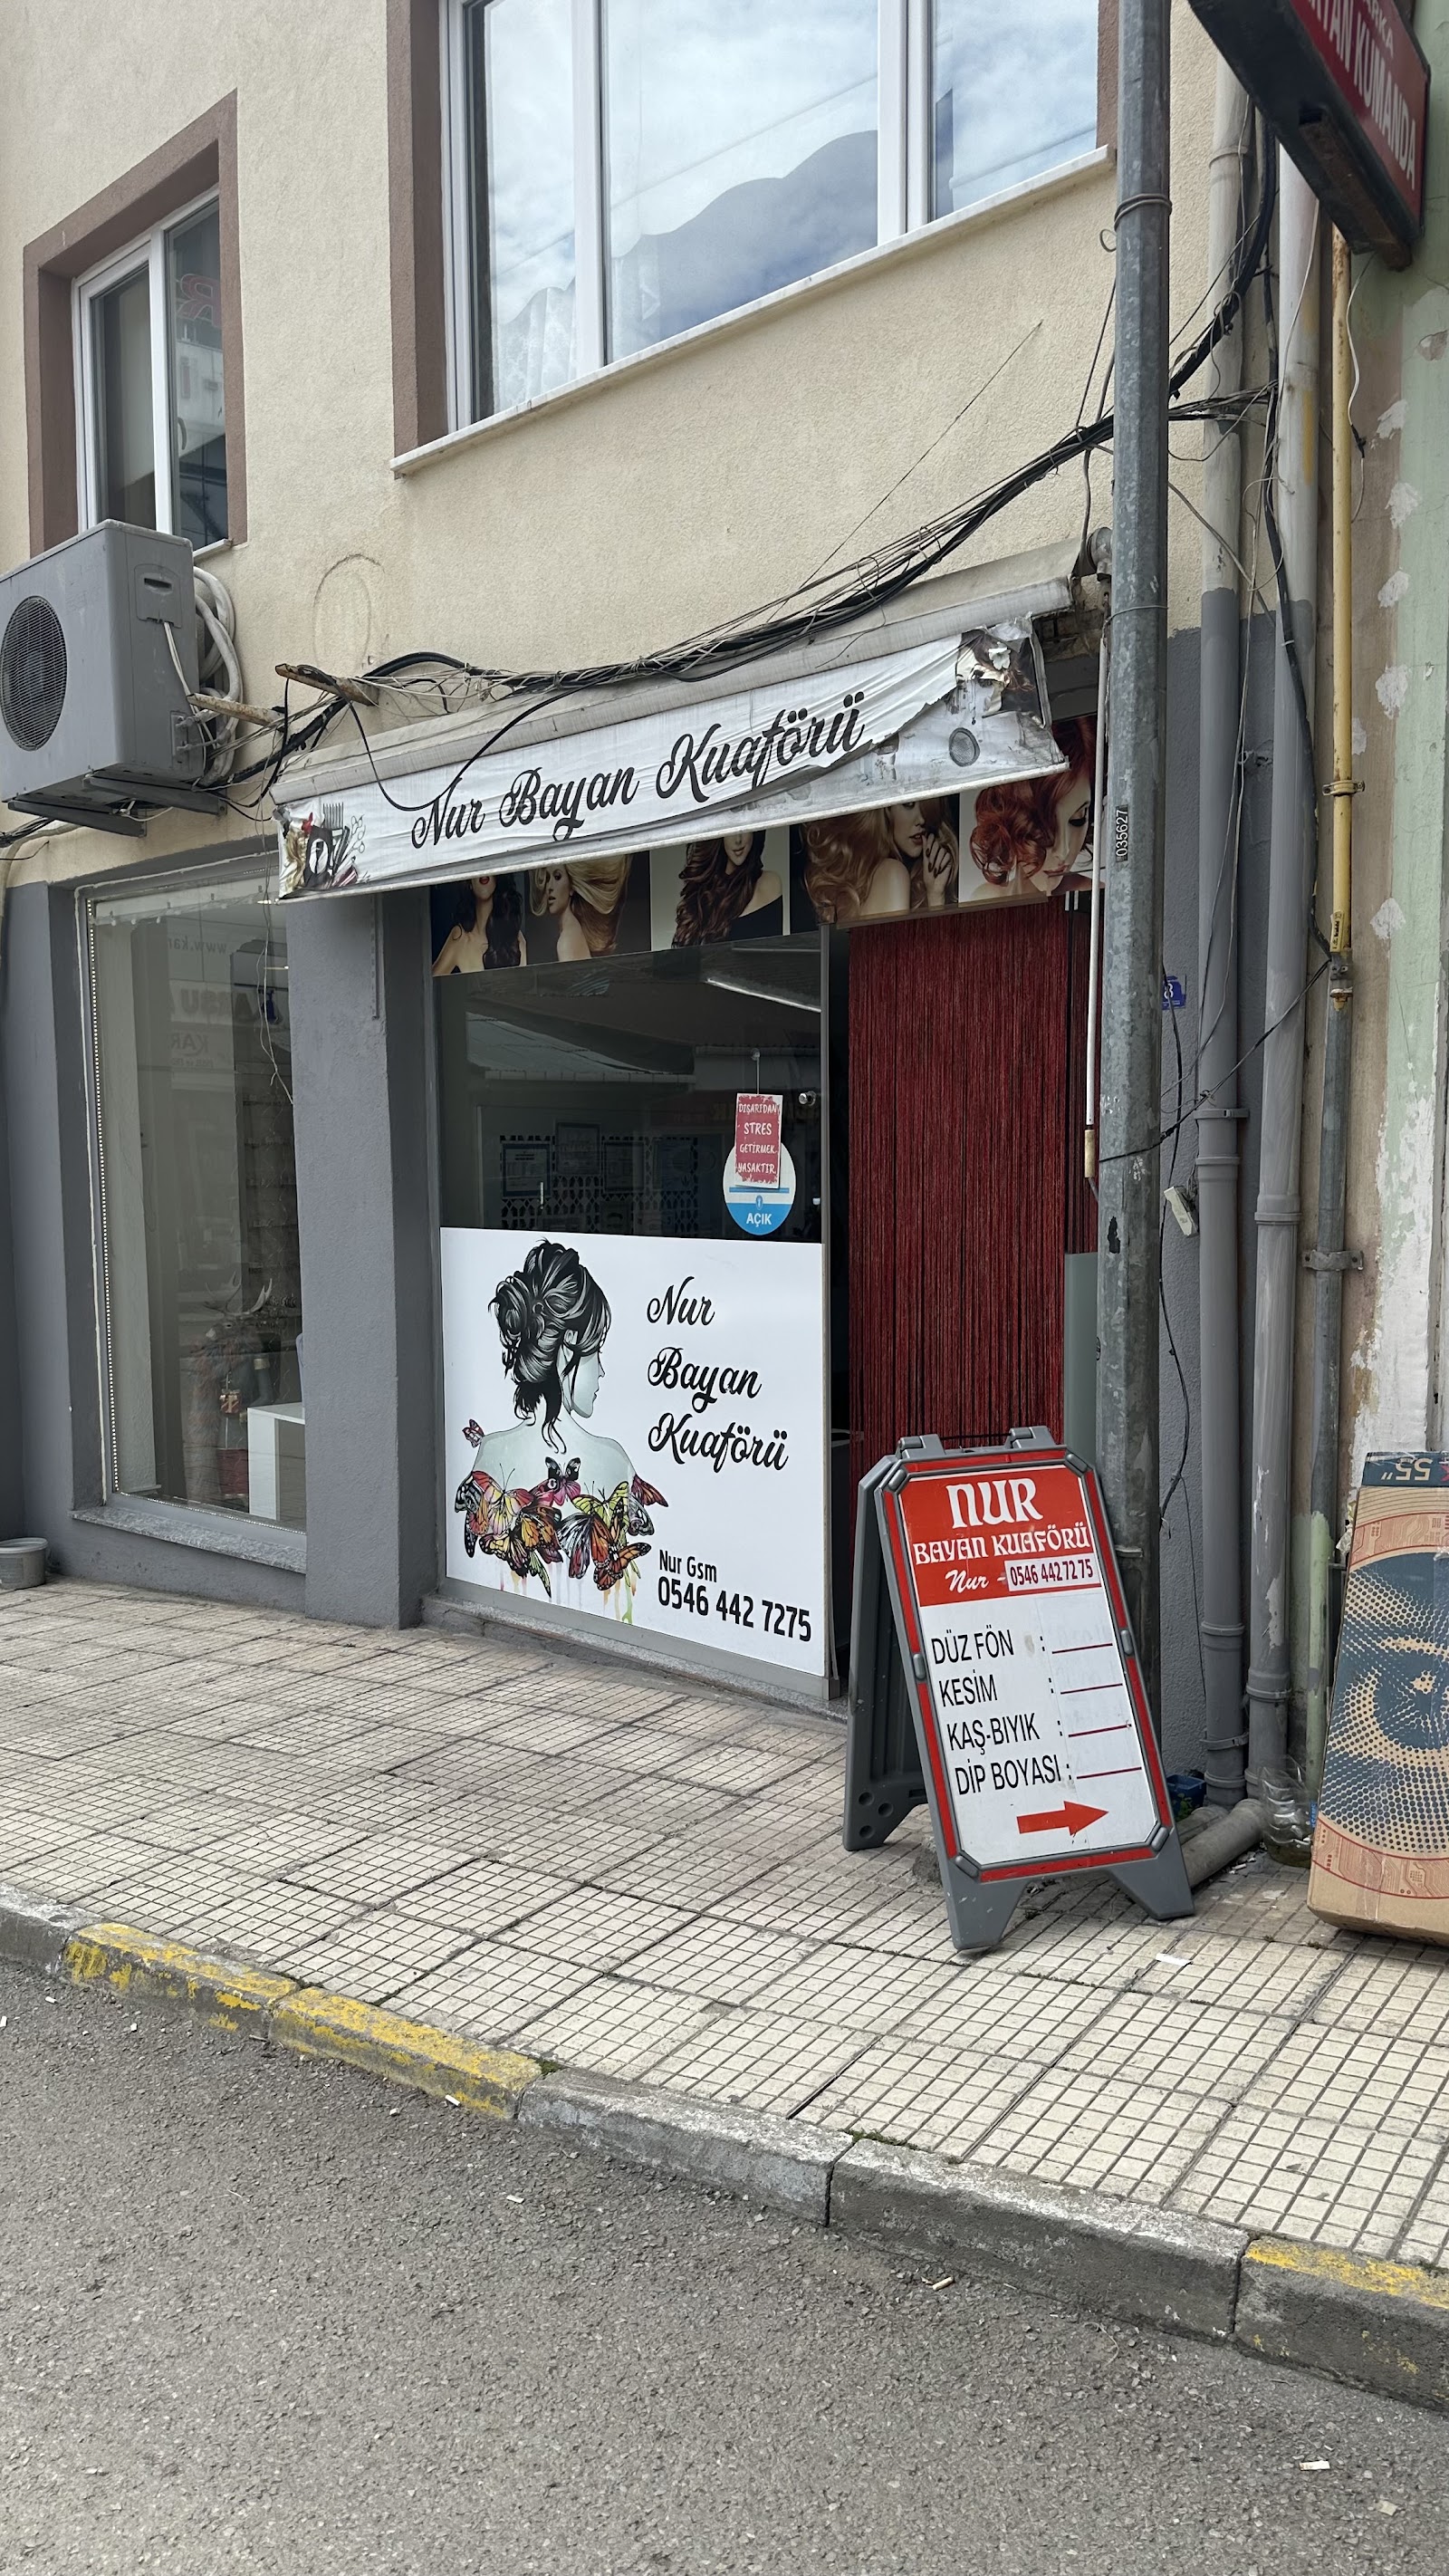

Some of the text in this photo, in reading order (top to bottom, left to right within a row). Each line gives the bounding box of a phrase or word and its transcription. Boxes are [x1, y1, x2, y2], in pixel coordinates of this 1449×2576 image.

[1354, 12, 1415, 191] KUMANDA
[411, 691, 866, 849] Nur Bayan Kuaförü
[1116, 810, 1128, 857] 035627
[744, 1122, 772, 1136] STRES
[746, 1213, 772, 1227] AÇIK
[647, 1275, 715, 1326] Nur
[648, 1347, 763, 1413] Bayan
[648, 1412, 789, 1473] Kuaförü
[946, 1477, 1043, 1529] NUR
[913, 1521, 1091, 1565] BAYAN KUAFÖRÜ
[659, 1549, 717, 1582] Nur Gsm
[945, 1569, 989, 1593] Nur
[1010, 1564, 1039, 1586] 0546
[658, 1576, 811, 1642] 0546 442 7275
[931, 1629, 972, 1665] DÜZ
[974, 1624, 1014, 1659] FÖN
[938, 1668, 998, 1707] KESİM
[946, 1712, 1041, 1755] KAŞ-BIYIK
[955, 1759, 986, 1795] DİP
[990, 1754, 1061, 1791] BOYASI
